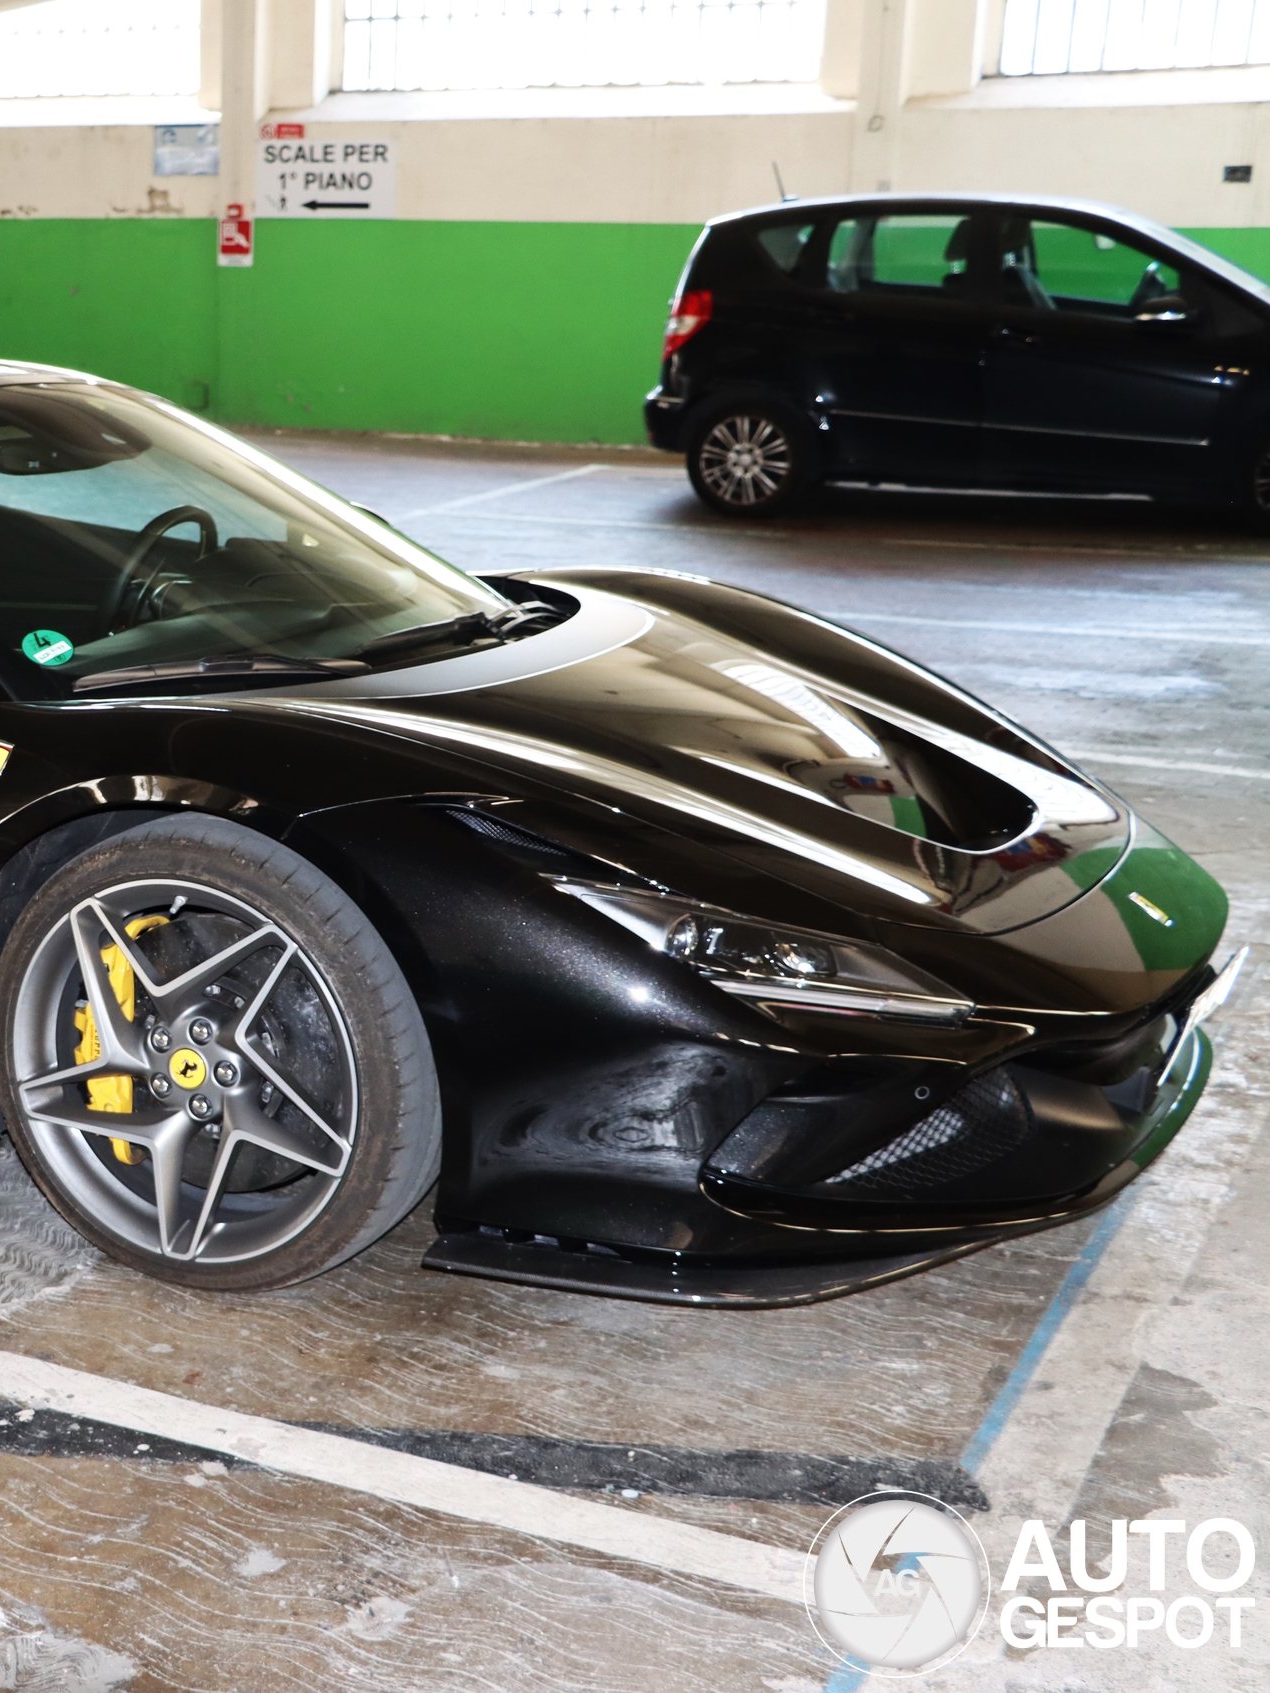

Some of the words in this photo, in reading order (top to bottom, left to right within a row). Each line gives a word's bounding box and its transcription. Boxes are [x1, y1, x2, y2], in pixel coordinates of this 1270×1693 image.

[264, 144, 336, 163] SCALE
[343, 144, 388, 163] PER
[304, 171, 373, 191] PIANO
